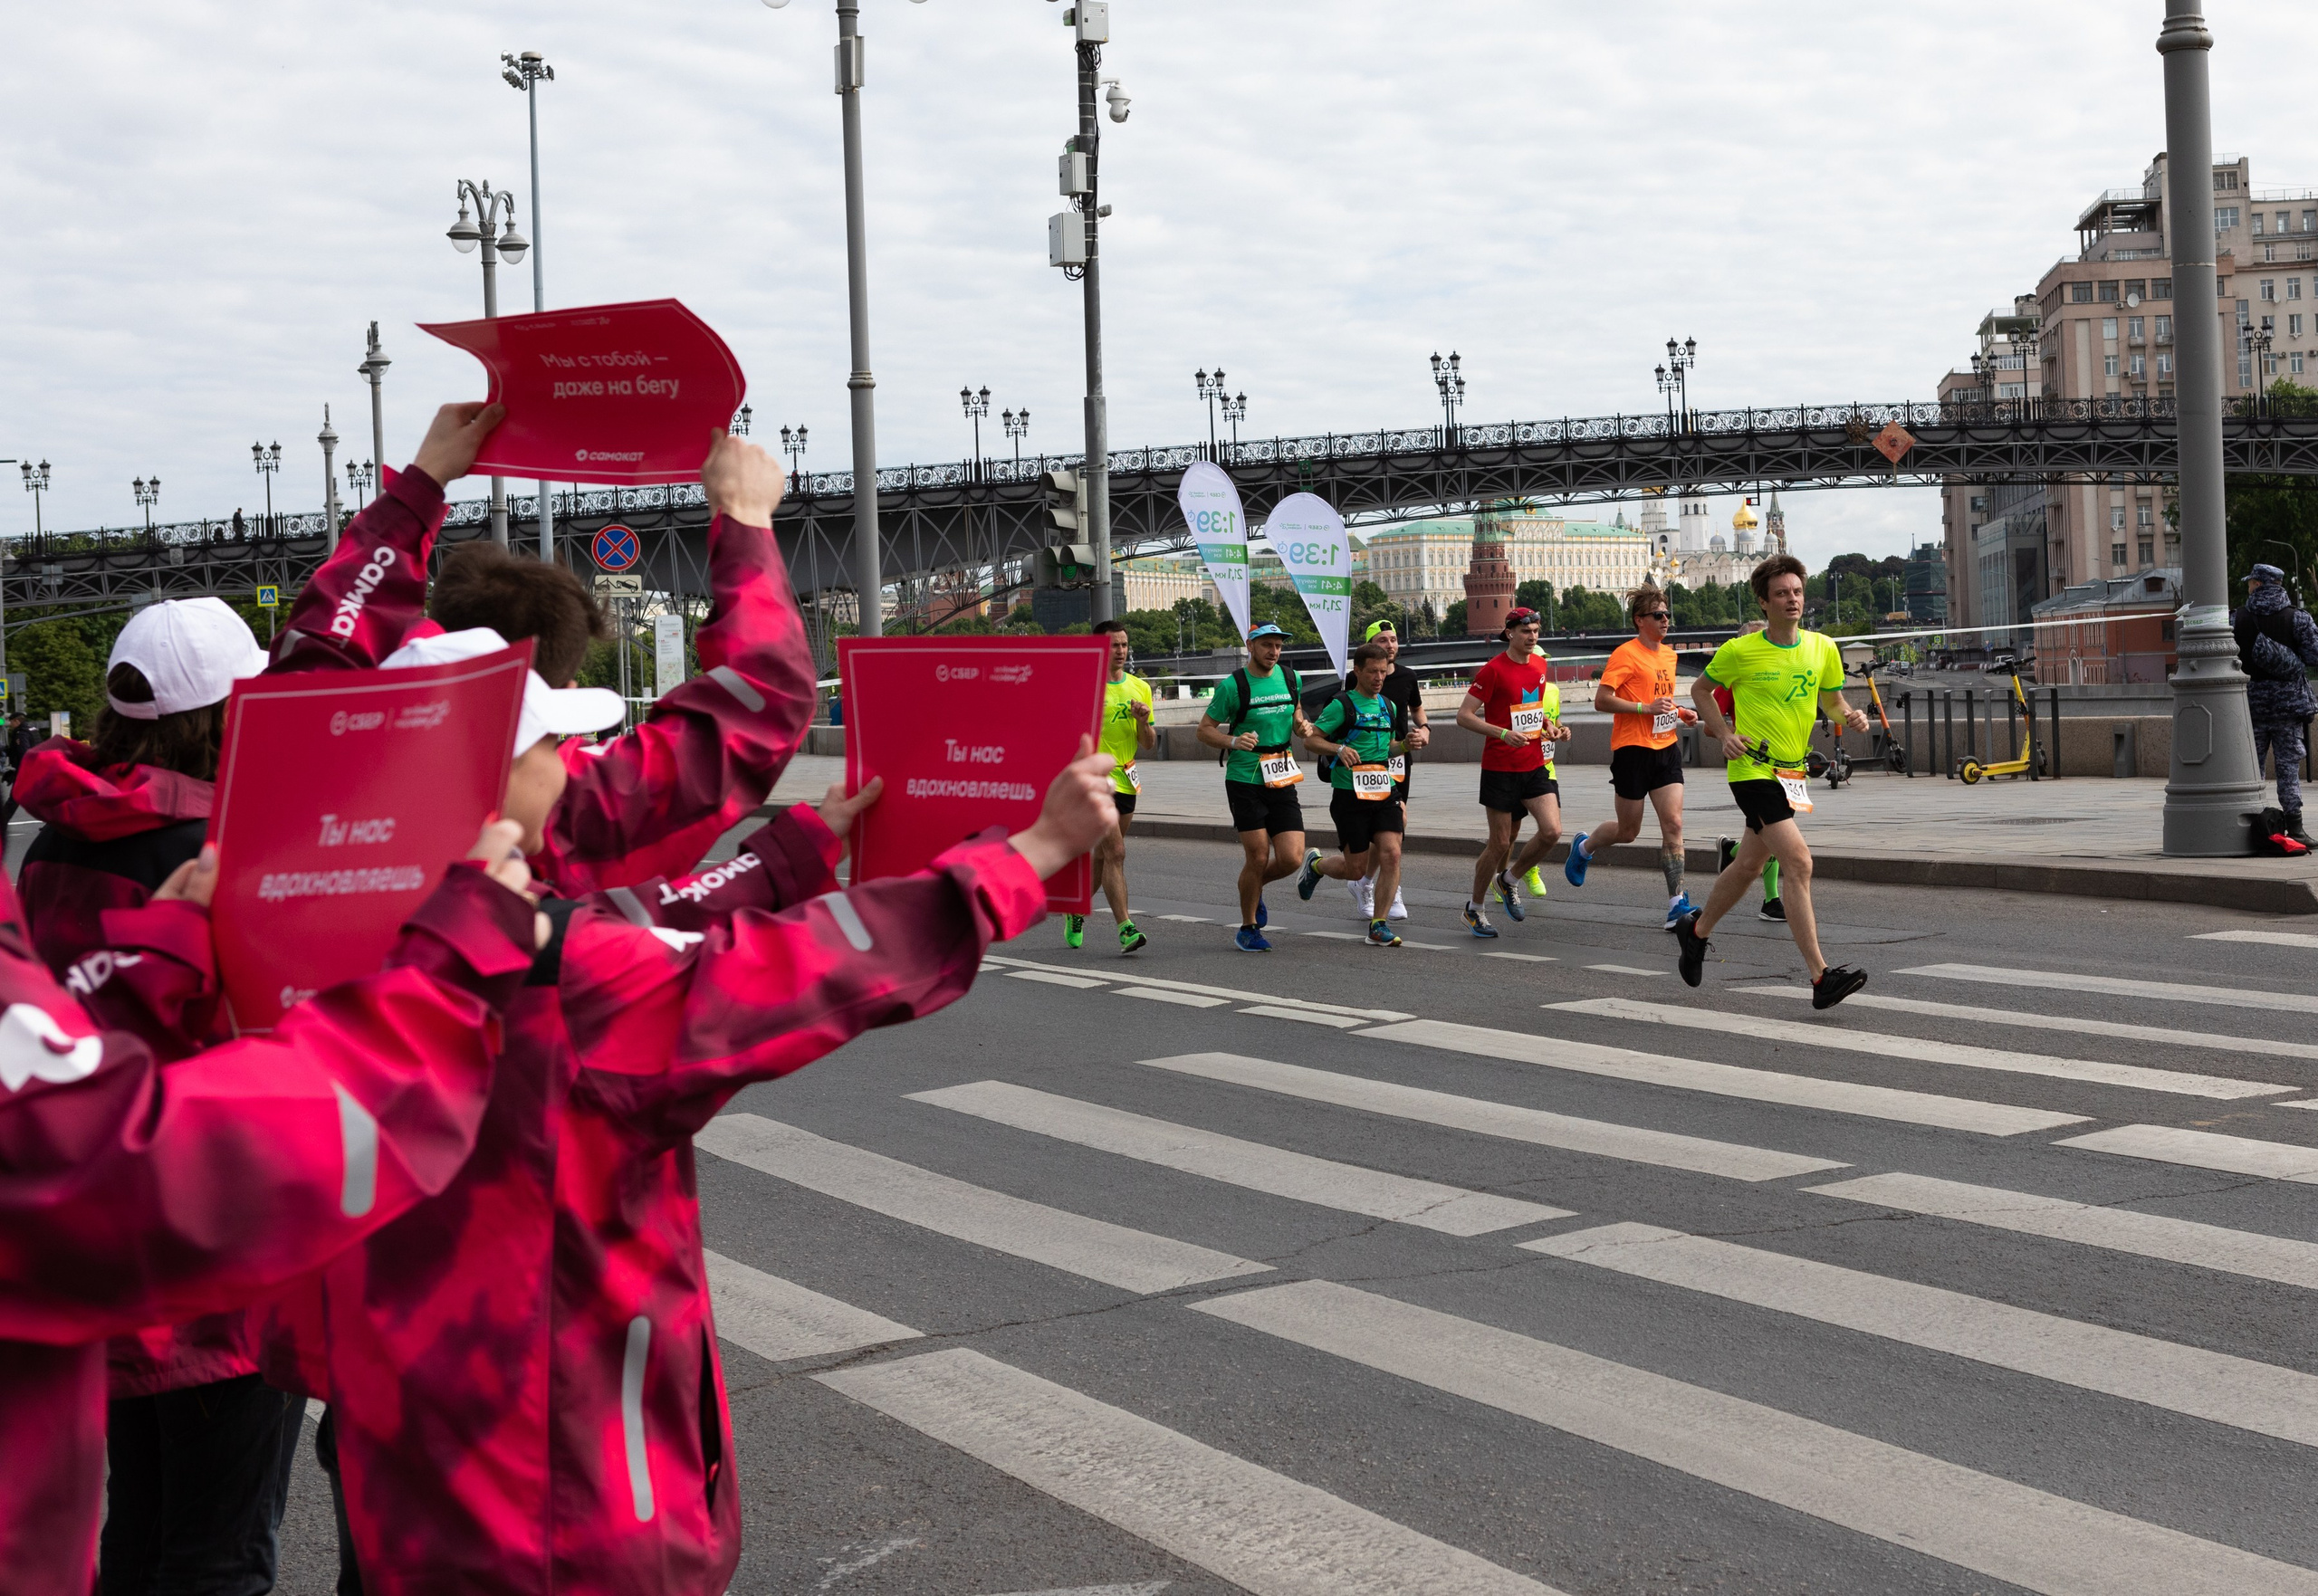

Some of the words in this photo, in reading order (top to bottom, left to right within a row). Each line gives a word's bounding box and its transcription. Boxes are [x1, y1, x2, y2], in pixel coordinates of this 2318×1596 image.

[539, 353, 576, 368] Мы
[577, 354, 591, 367] с
[591, 350, 651, 367] тобой
[553, 380, 604, 399] даже
[608, 379, 632, 396] на
[636, 374, 679, 400] бегу
[589, 451, 645, 462] самокат
[328, 546, 396, 649] самкат
[1654, 683, 1673, 695] RUN
[1250, 693, 1291, 704] ЕЙСМЕЙКЕР
[1514, 712, 1543, 726] 10862
[944, 739, 966, 763] Ты
[970, 744, 1006, 764] нас
[1264, 760, 1295, 775] 1081
[906, 778, 1036, 801] вдохновляешь
[1355, 774, 1389, 787] 10800
[318, 814, 348, 847] Ты
[349, 817, 396, 845] нас
[258, 865, 426, 903] вдохновляешь
